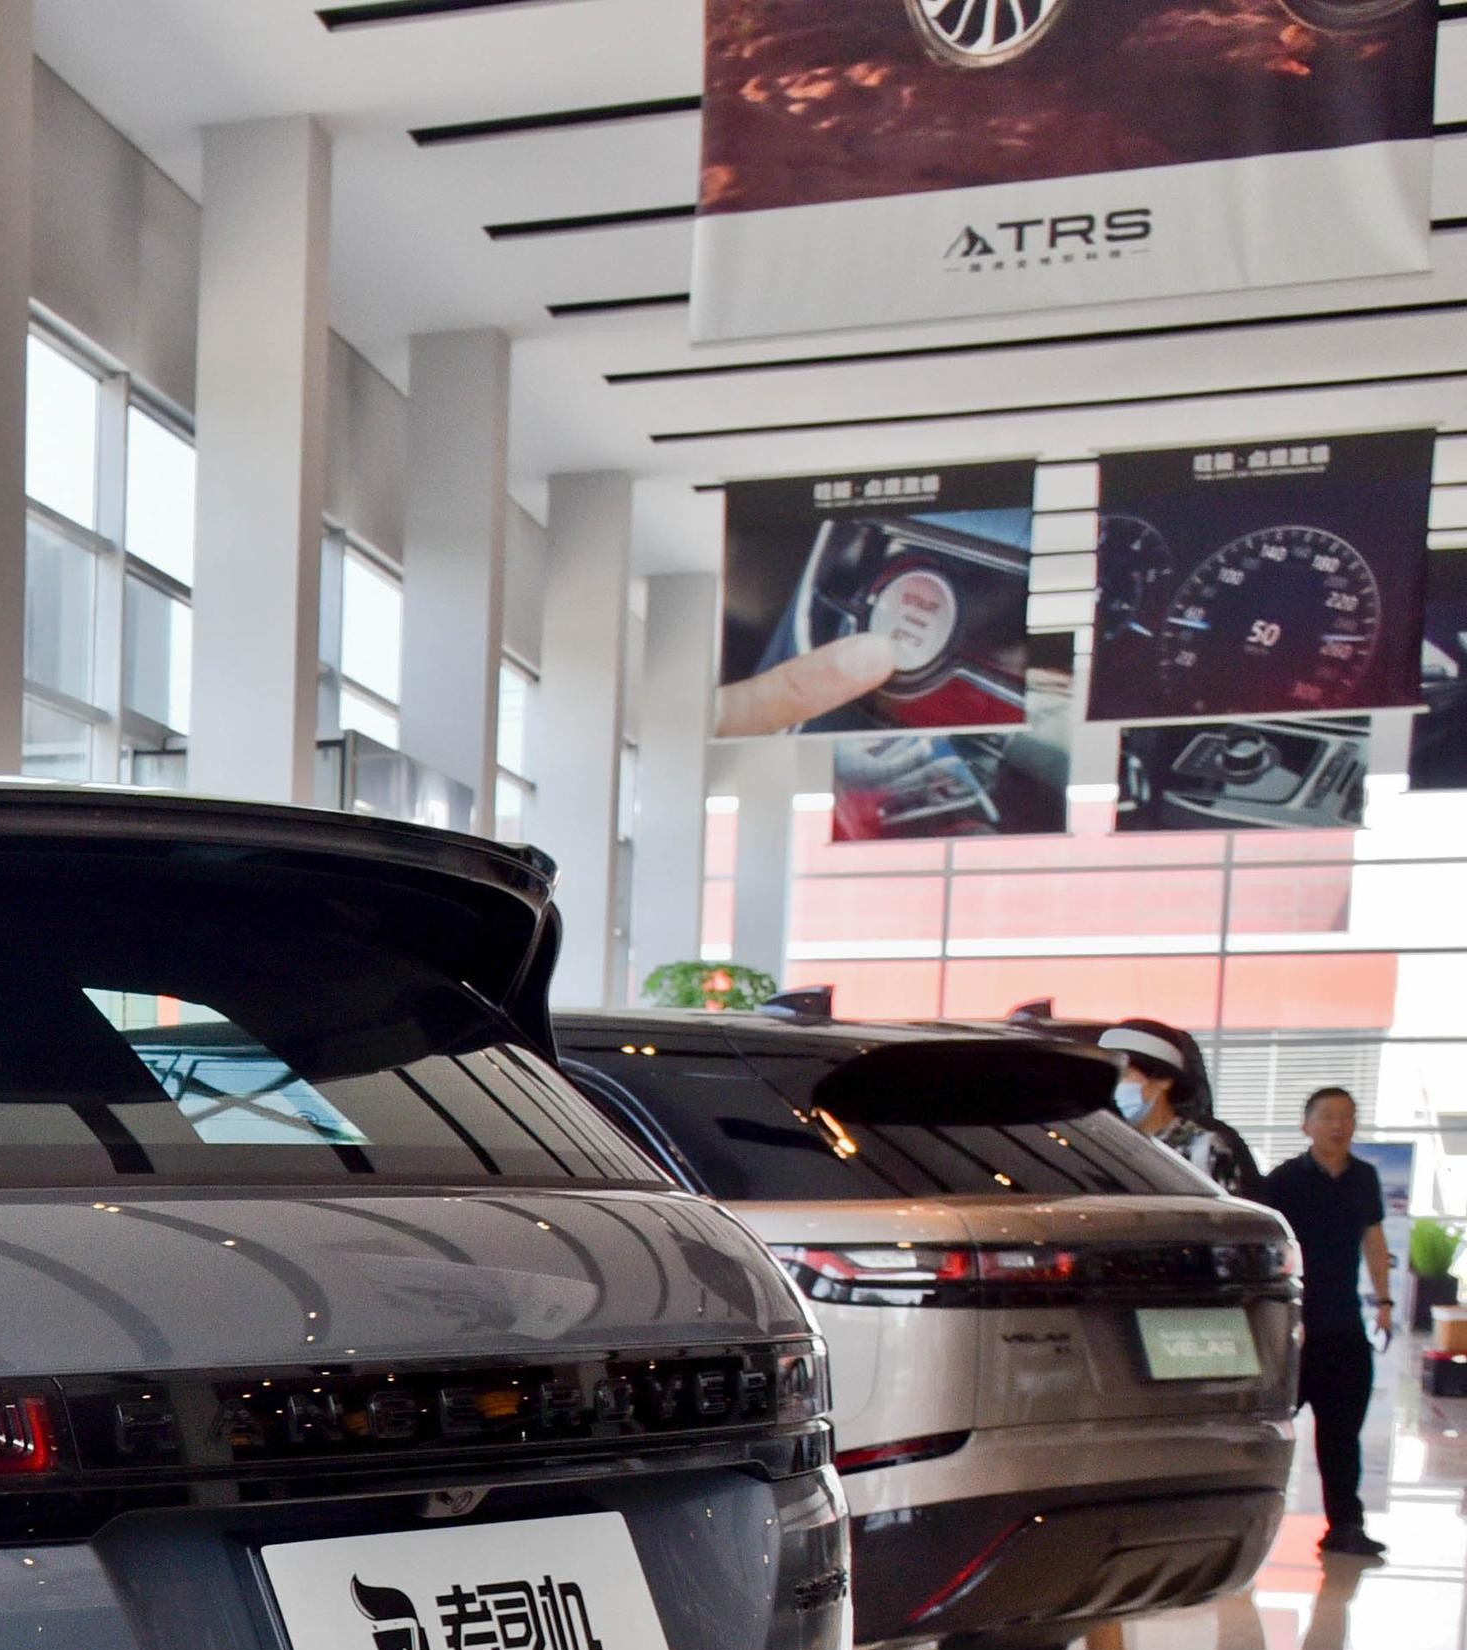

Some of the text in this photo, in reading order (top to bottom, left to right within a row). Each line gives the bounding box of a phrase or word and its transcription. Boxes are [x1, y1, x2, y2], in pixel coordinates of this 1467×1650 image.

[1246, 619, 1282, 648] 50
[115, 1369, 769, 1454] RANGE ROVER
